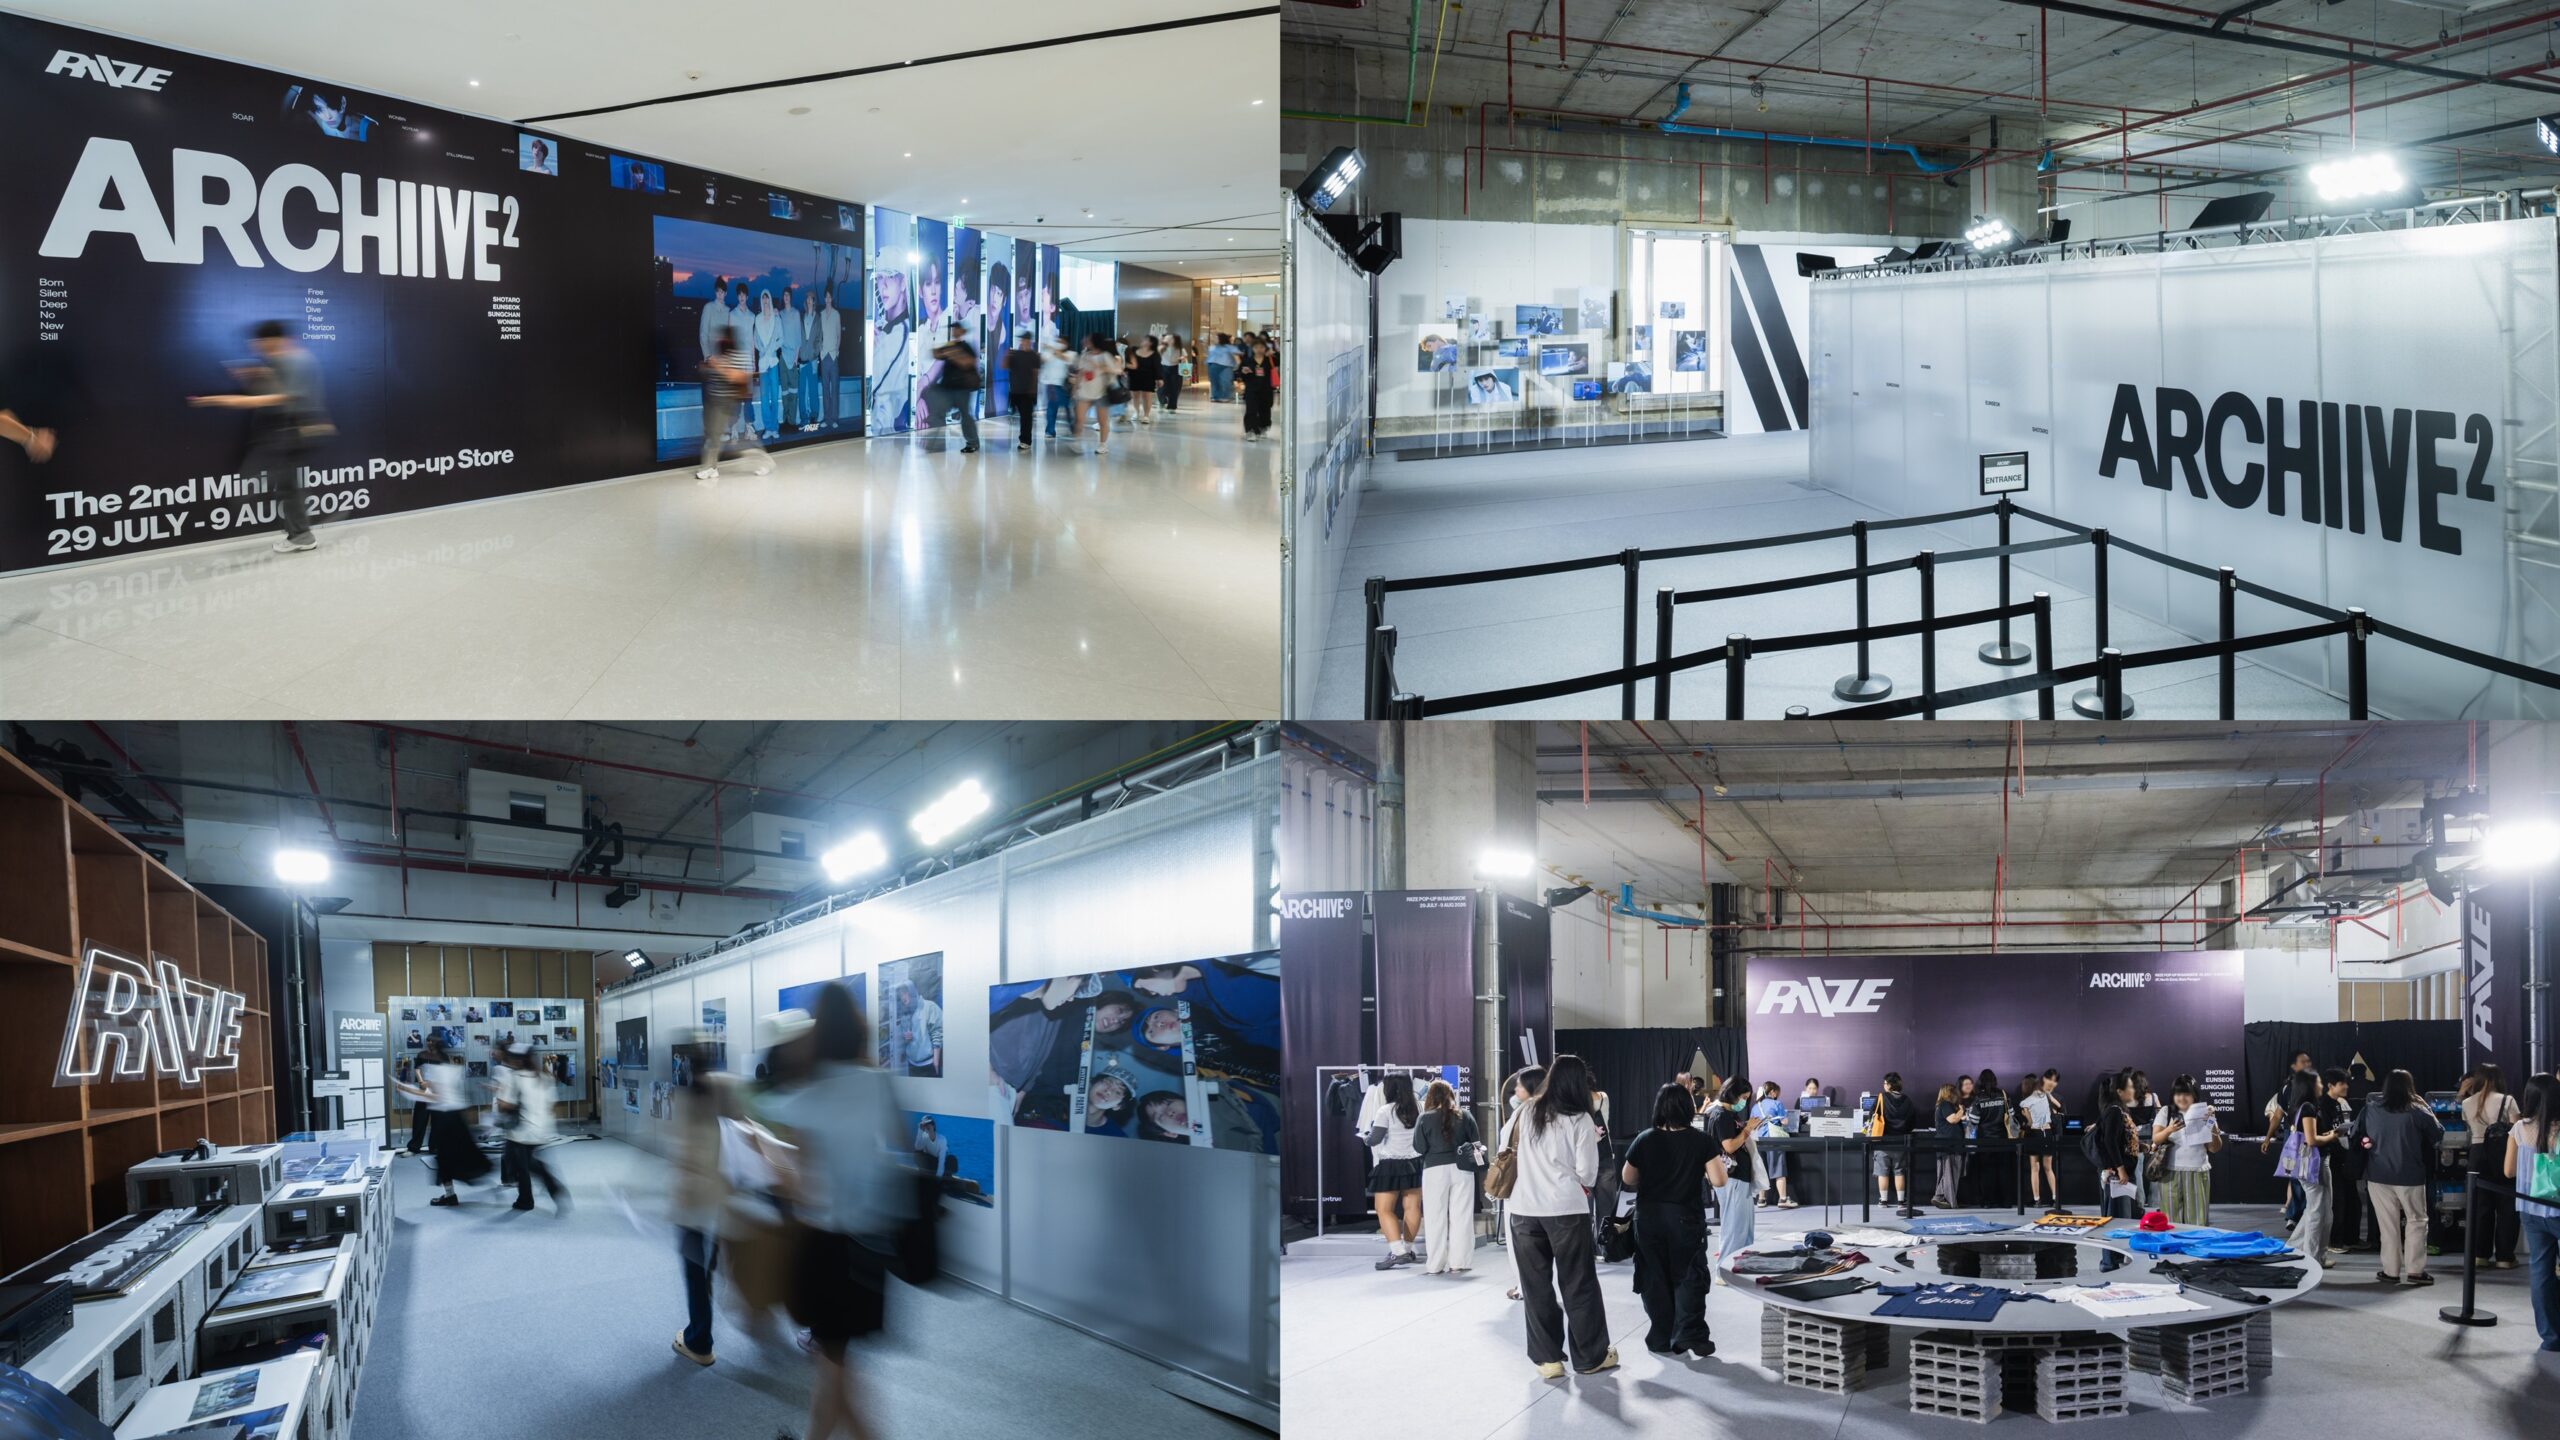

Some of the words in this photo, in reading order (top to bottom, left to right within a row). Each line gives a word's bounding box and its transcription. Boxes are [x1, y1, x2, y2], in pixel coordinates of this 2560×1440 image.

[232, 112, 254, 122] SOAR
[39, 278, 64, 287] Born
[39, 289, 68, 298] Silent
[307, 288, 324, 296] Free
[39, 300, 68, 309] Deep
[304, 297, 329, 305] Walker
[40, 311, 56, 319] No
[40, 321, 64, 330] New
[40, 332, 59, 341] Still
[302, 333, 336, 341] Dreaming
[1985, 474, 2022, 484] ENTRANCE
[45, 490, 123, 520] The
[128, 478, 197, 510] 2nd
[203, 470, 268, 501] Mini
[273, 464, 364, 489] lbum
[368, 455, 455, 480] Pop-up
[457, 449, 514, 469] Store
[47, 525, 97, 556] 29
[102, 511, 189, 547] JULY
[209, 507, 231, 530] 9
[305, 488, 370, 517] 2026
[1979, 1100, 2005, 1109] RAIDERS
